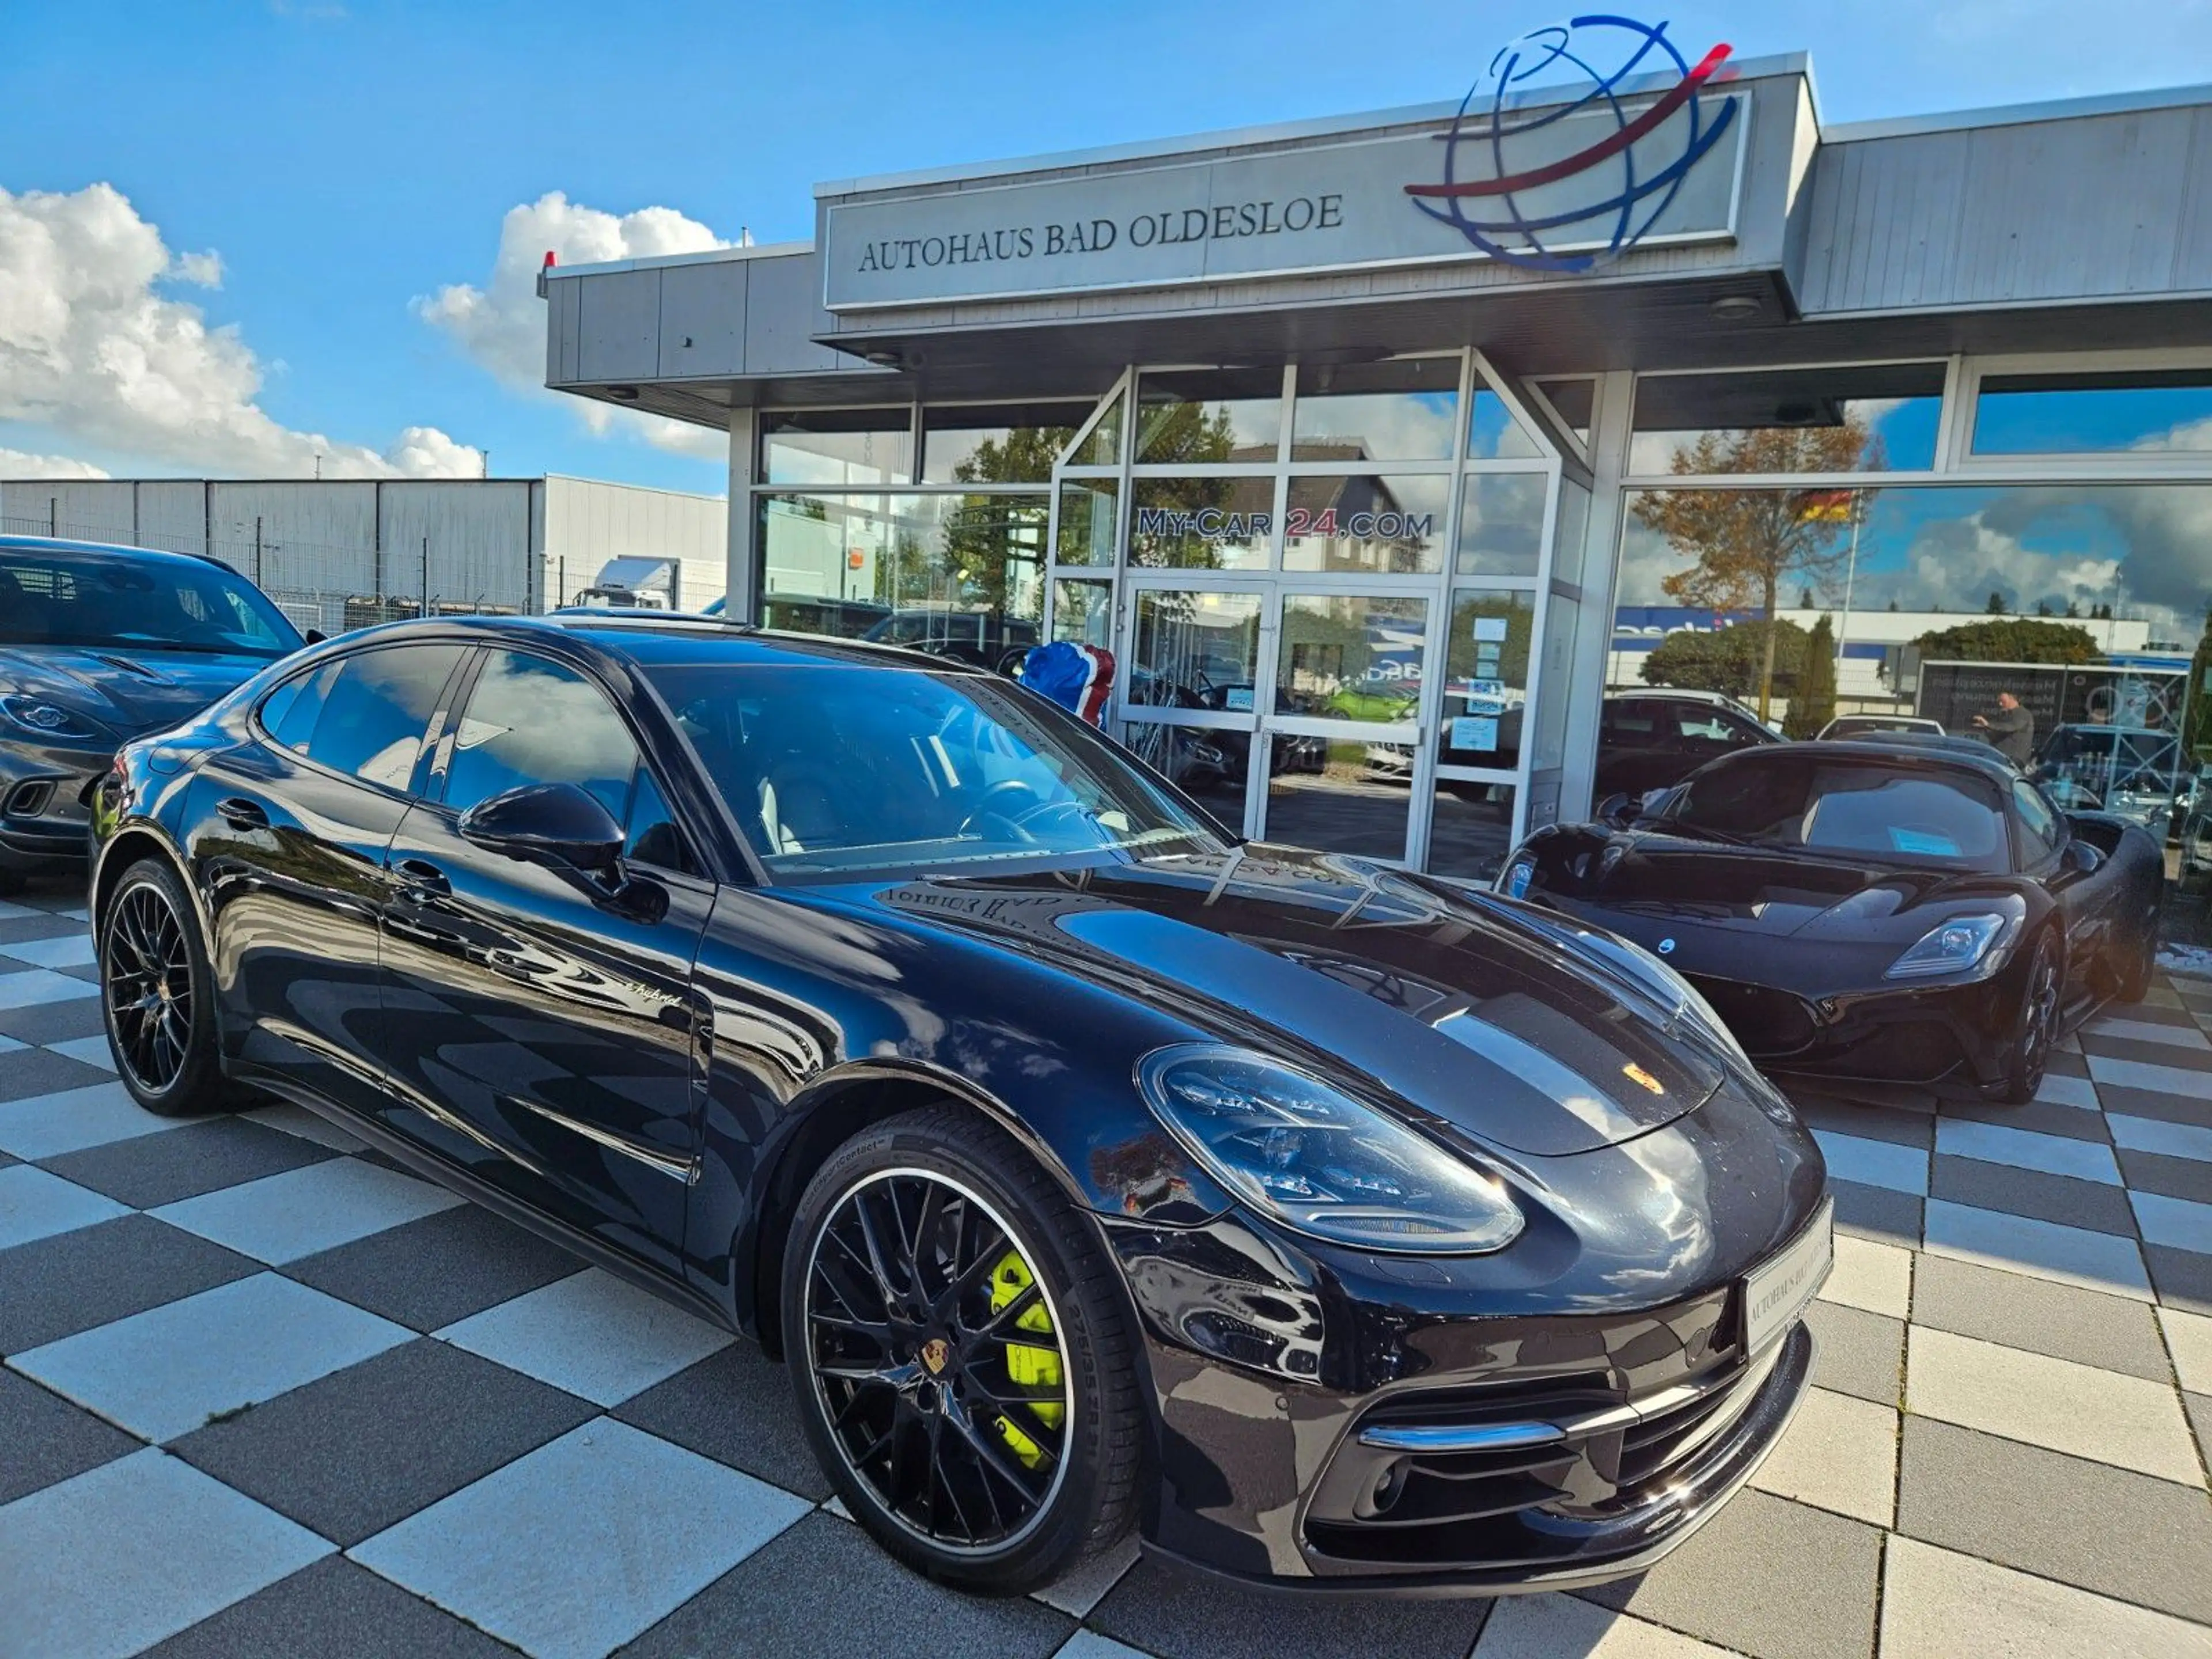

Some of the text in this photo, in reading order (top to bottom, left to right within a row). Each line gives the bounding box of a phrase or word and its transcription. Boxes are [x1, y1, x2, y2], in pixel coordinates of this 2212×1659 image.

[858, 194, 1343, 272] AUTOHAUS BAD OLDESLOE
